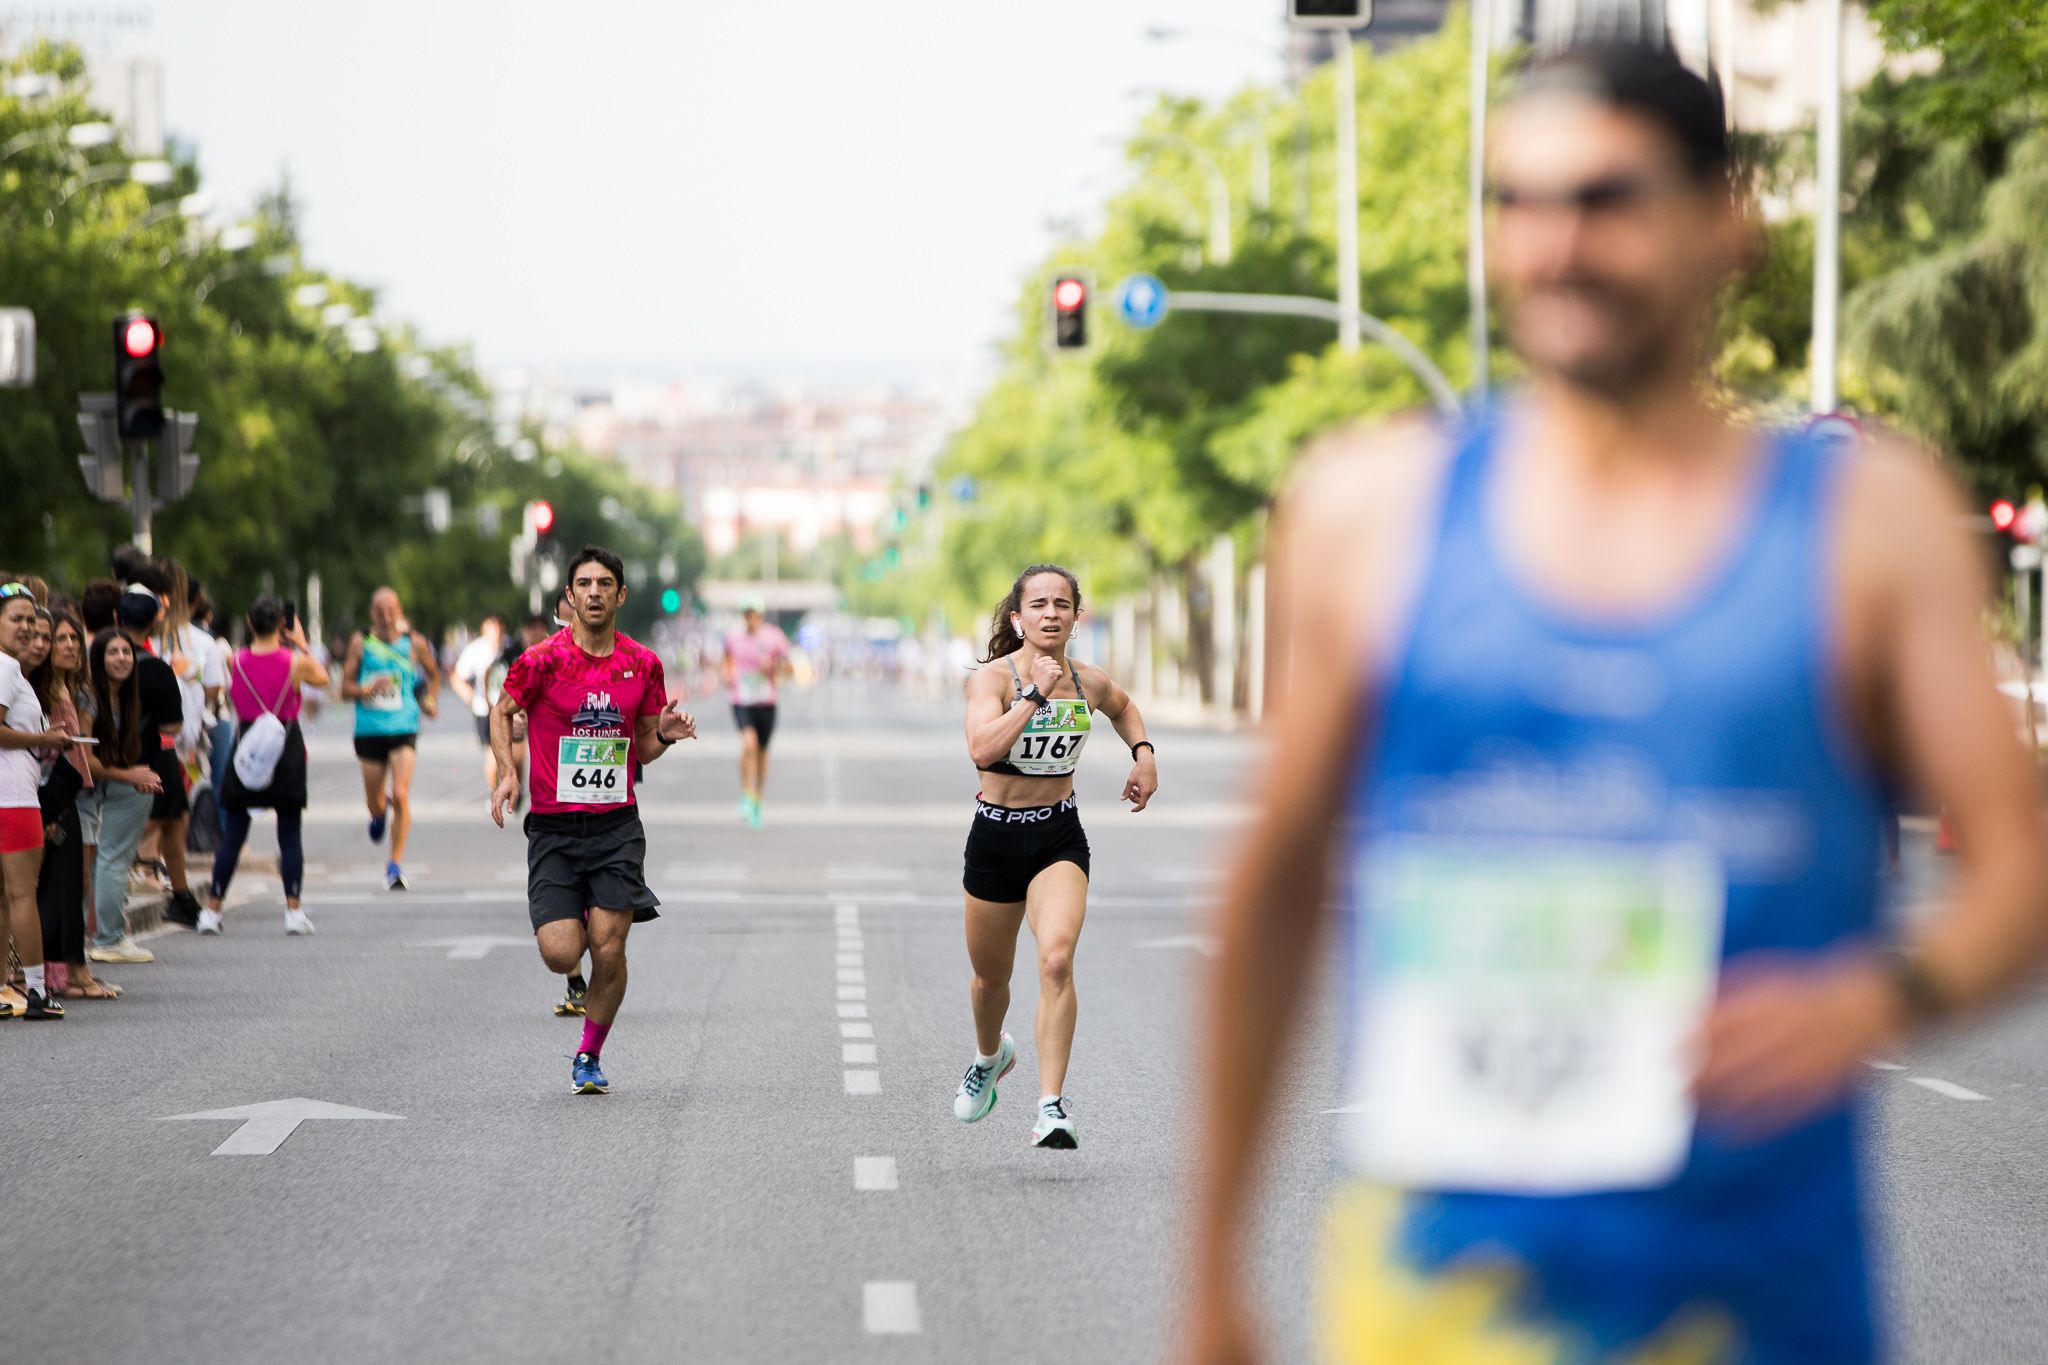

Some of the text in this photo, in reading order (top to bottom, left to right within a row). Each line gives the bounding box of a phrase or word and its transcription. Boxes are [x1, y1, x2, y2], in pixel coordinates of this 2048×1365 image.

[573, 727, 621, 737] LOS LUNES
[575, 745, 615, 763] ELA
[1020, 735, 1083, 759] 1767
[572, 768, 616, 789] 646
[1006, 807, 1052, 824] PRO
